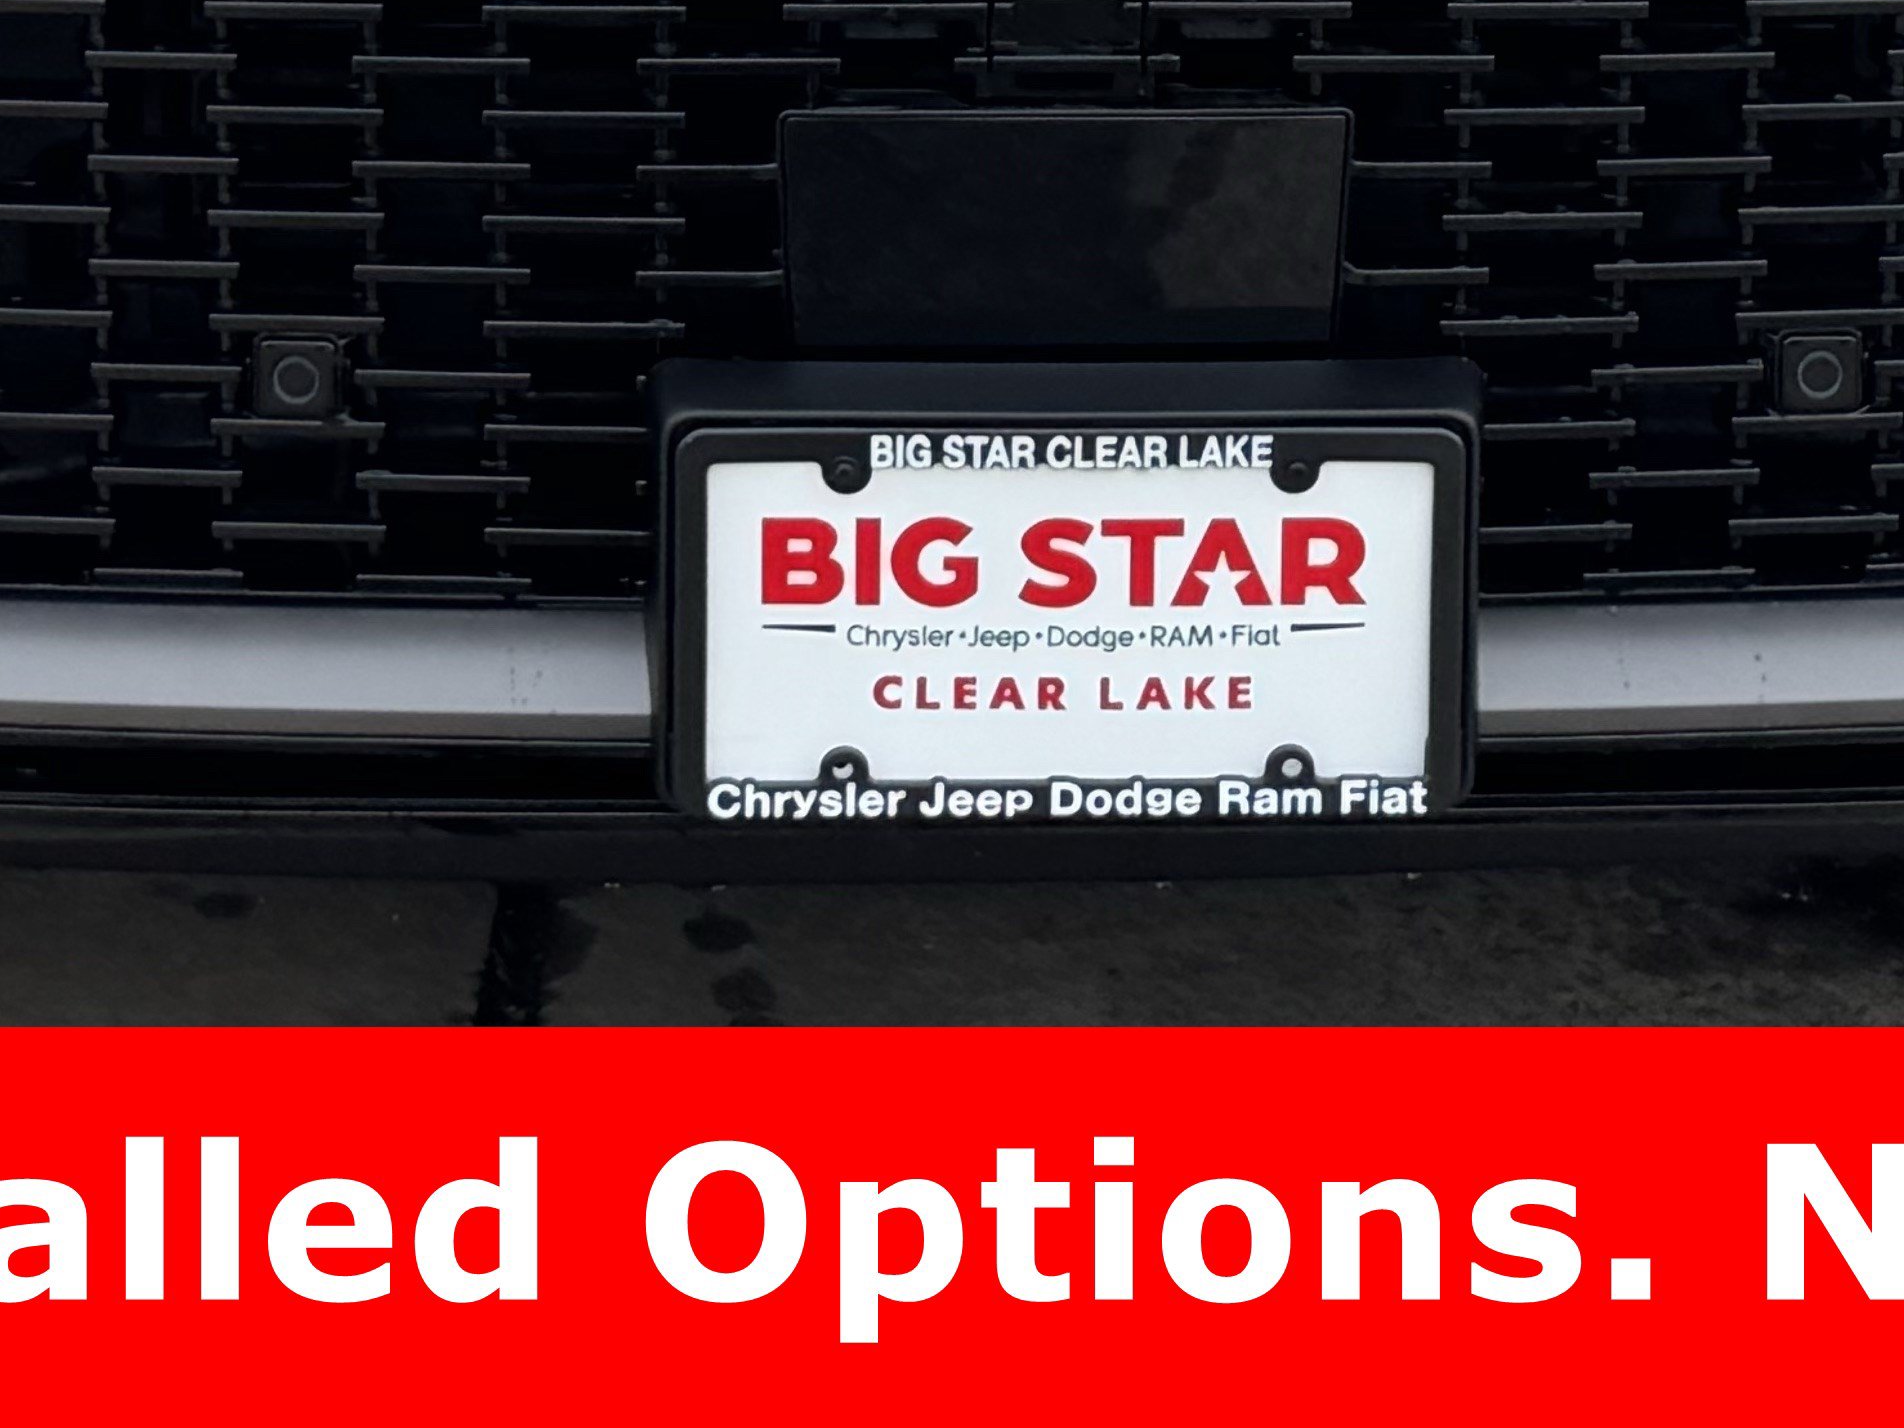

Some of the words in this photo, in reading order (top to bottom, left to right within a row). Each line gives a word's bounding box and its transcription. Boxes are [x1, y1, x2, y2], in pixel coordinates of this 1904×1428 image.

[870, 435, 932, 469] BIG
[942, 435, 1035, 469] STAR
[1045, 435, 1167, 470] CLEAR
[1179, 435, 1274, 469] LAKE
[760, 517, 979, 607] BIG
[1018, 517, 1367, 607] STAR
[872, 675, 1067, 712] CLEAR
[1099, 675, 1254, 712] LAKE
[706, 781, 906, 821] Chrysler
[919, 782, 1033, 819] Jeep
[1049, 781, 1201, 818] Dodge
[1217, 781, 1323, 817] Ram
[1339, 779, 1428, 817] Fiat
